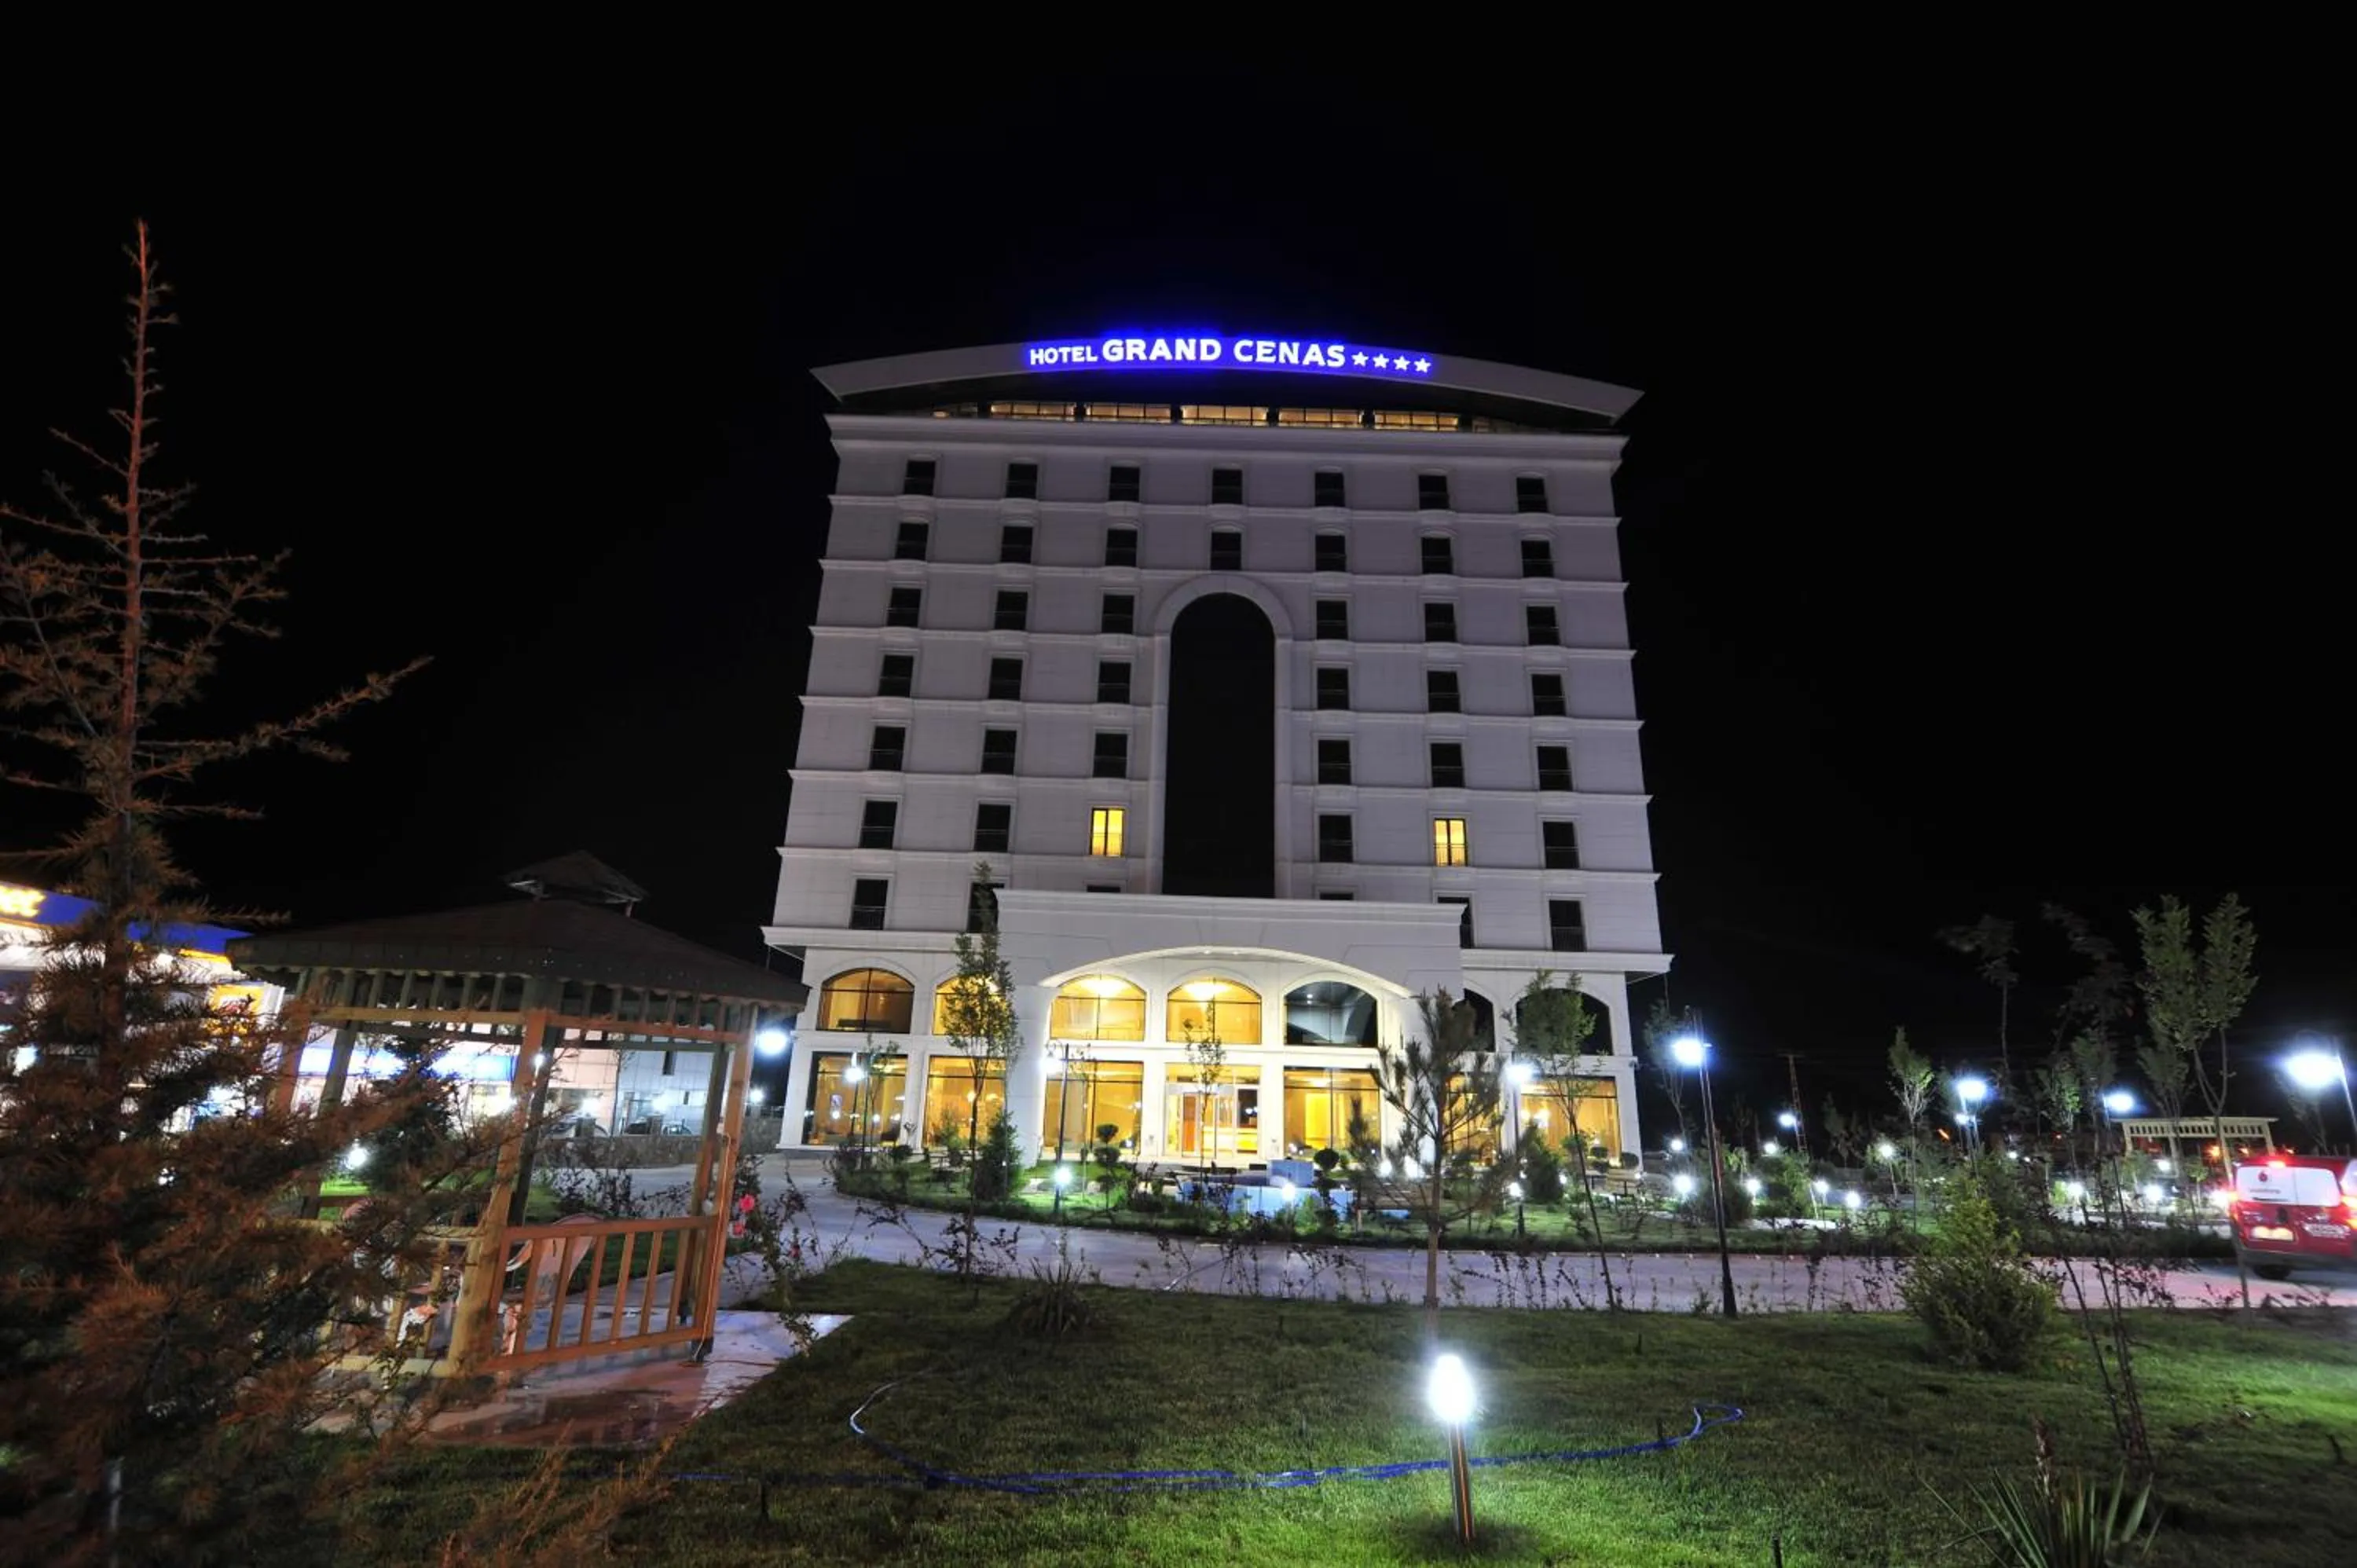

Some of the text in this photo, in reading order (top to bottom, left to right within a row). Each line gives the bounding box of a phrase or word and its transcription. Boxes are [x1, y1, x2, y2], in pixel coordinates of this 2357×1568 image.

[1030, 339, 1346, 368] HOTEL GRAND CENAS
